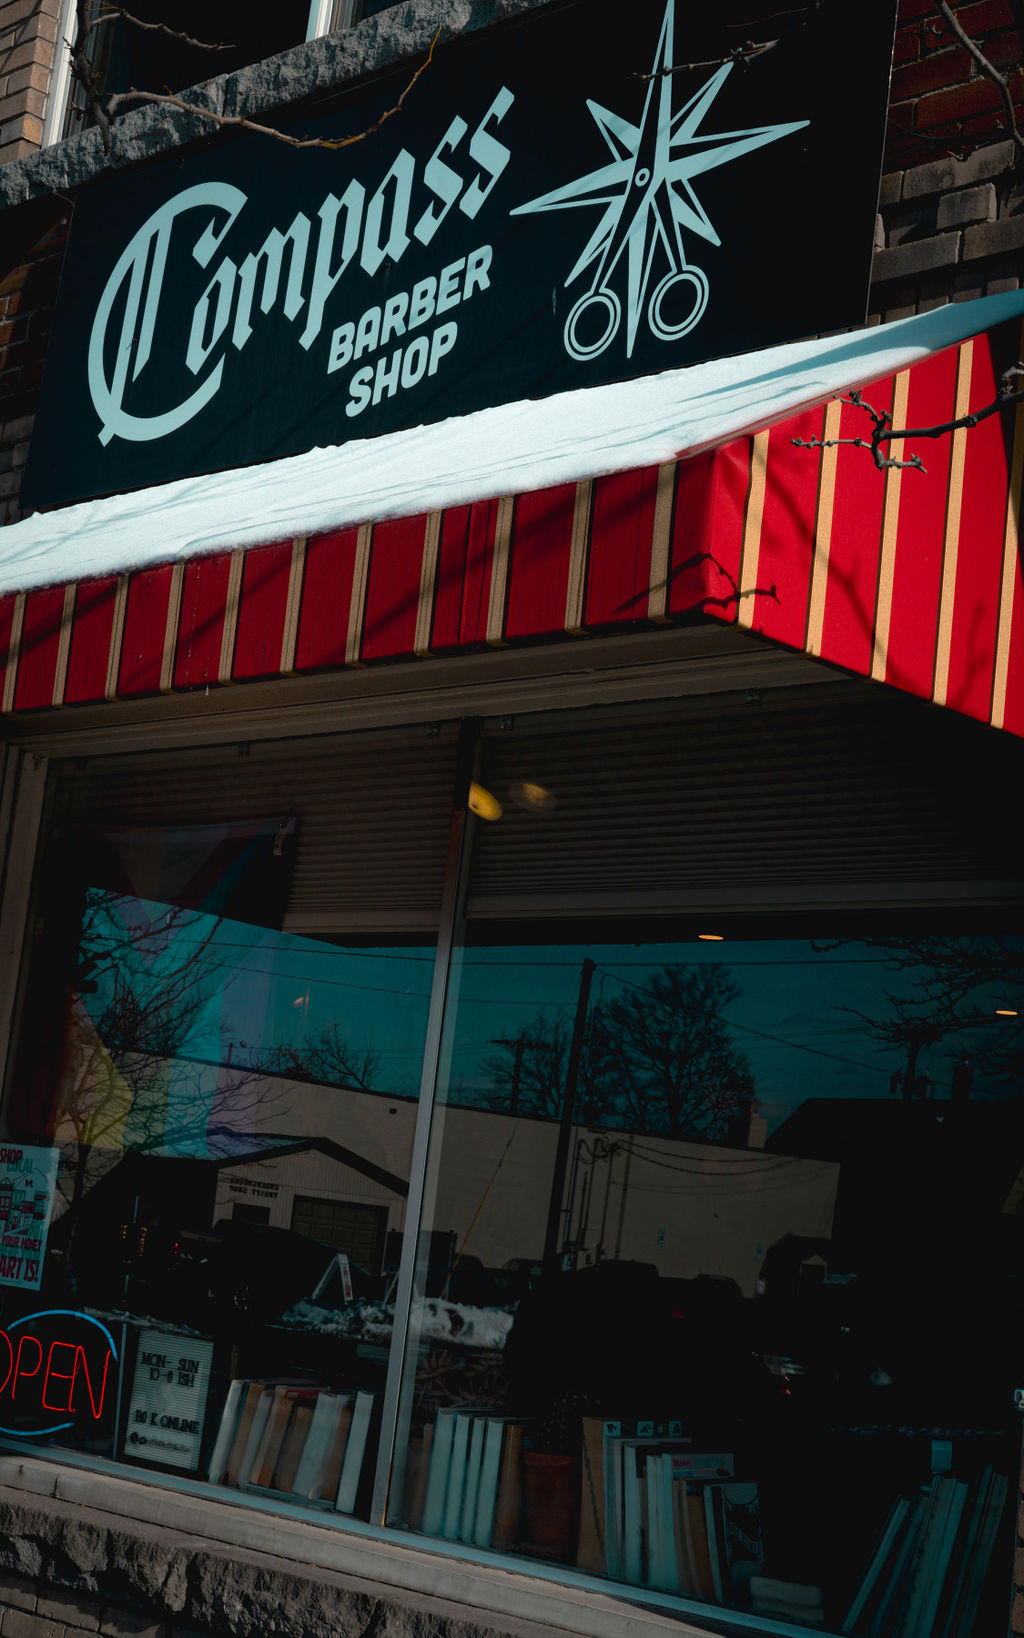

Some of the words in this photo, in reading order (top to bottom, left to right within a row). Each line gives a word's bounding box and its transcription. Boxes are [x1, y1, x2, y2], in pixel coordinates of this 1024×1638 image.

[88, 87, 514, 447] Compass
[327, 245, 492, 374] BARBER
[346, 322, 457, 417] SHOP
[0, 1147, 23, 1165] SHOP
[2, 1234, 20, 1248] YOUR
[21, 1237, 42, 1251] MONEY
[0, 1331, 112, 1419] PEN
[178, 1358, 200, 1373] SUN
[178, 1372, 195, 1387] ISH
[160, 1414, 200, 1434] ONLINE
